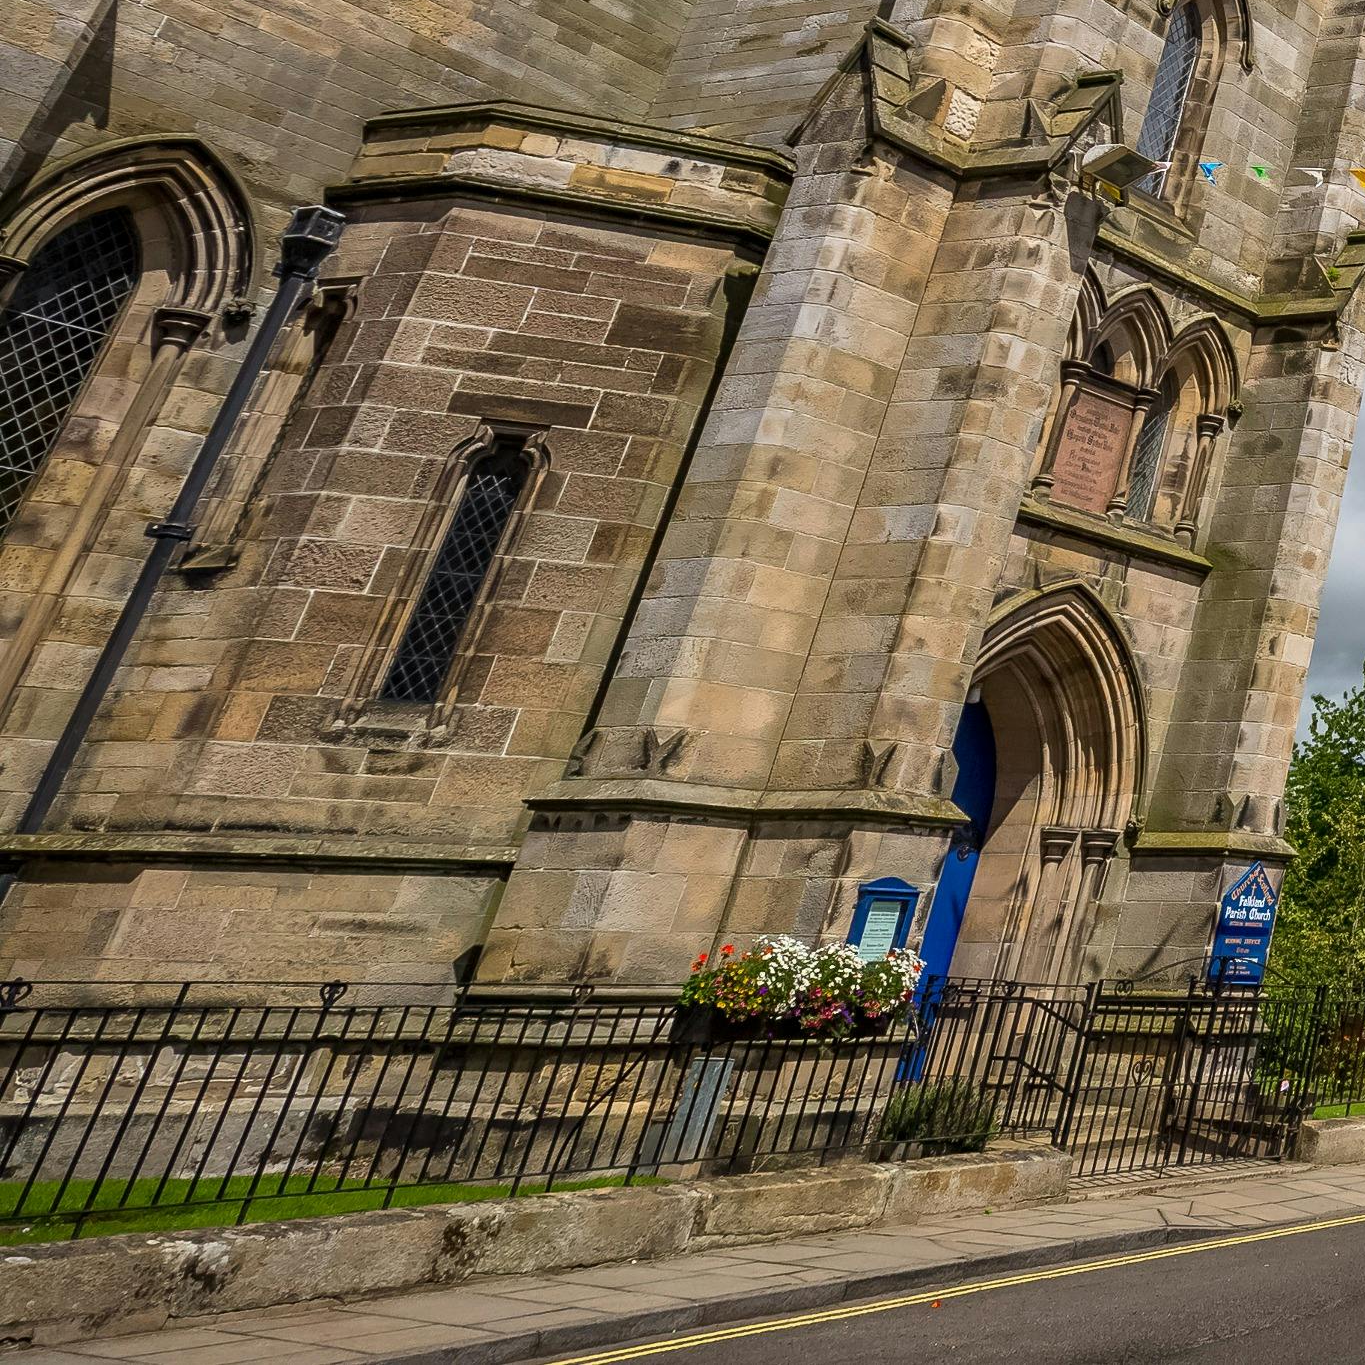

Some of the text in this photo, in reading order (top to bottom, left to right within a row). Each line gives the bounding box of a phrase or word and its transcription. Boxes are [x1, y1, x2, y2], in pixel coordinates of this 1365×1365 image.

[1231, 875, 1255, 901] Church
[1239, 895, 1266, 907] Falkland
[1225, 906, 1271, 921] Parish Church
